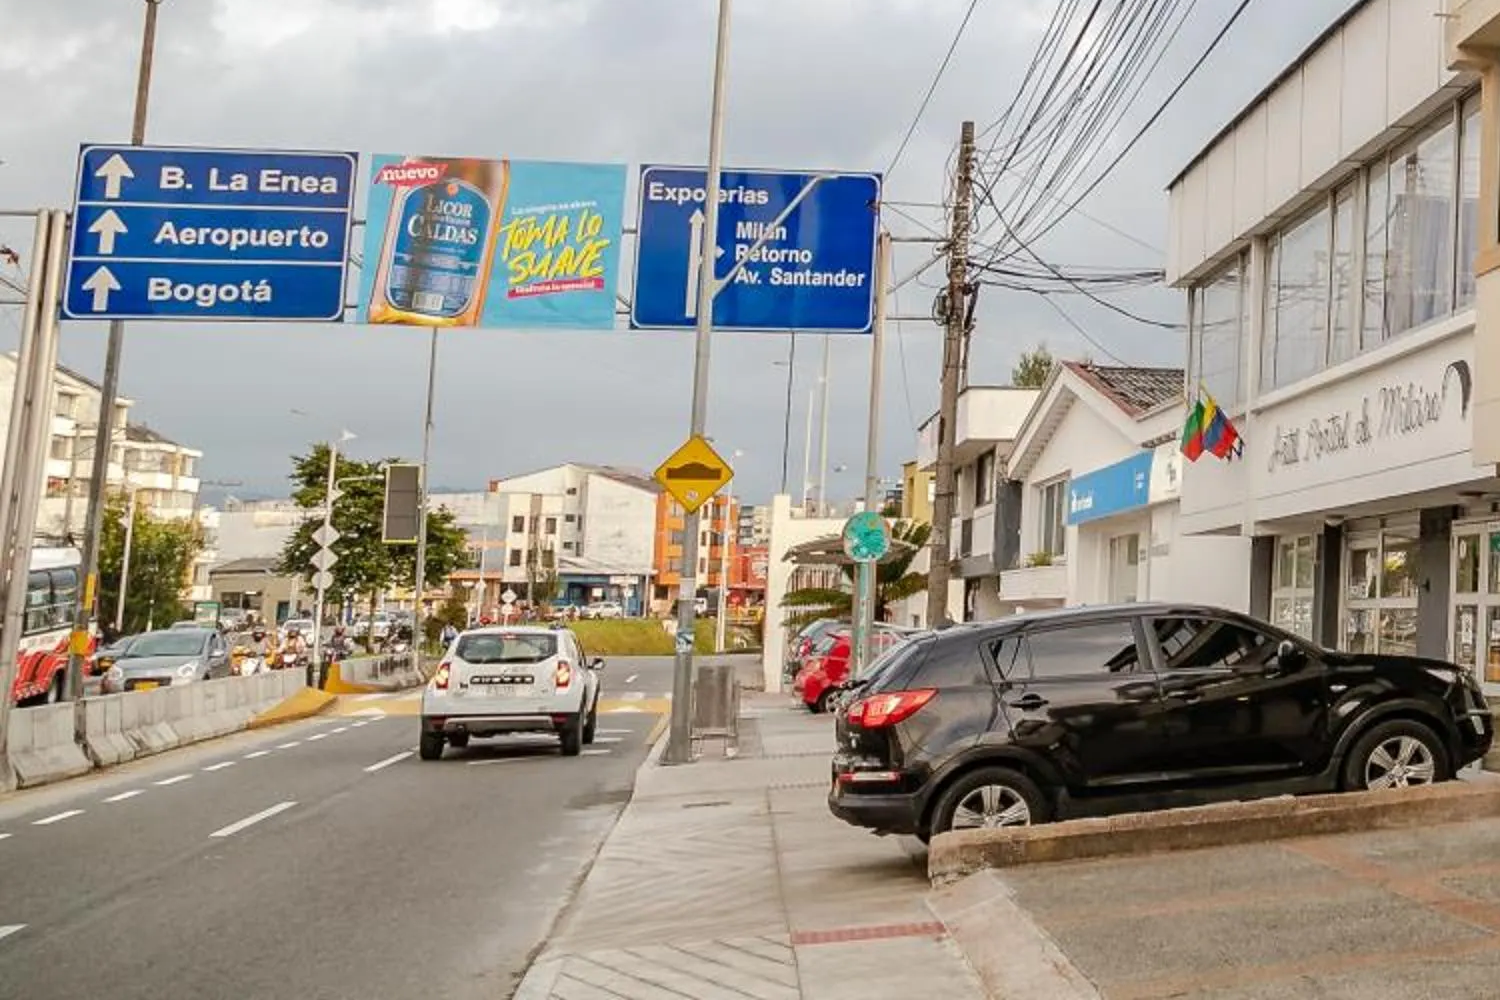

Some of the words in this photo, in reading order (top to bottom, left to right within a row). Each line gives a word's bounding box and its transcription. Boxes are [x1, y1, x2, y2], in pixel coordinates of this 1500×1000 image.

[159, 165, 193, 190] B.
[208, 167, 249, 192] La
[258, 168, 338, 194] Enea
[382, 167, 439, 181] nuevo
[648, 181, 770, 206] Expoerias
[154, 220, 329, 251] Aeropuerto
[507, 237, 610, 284] SUAVE
[735, 243, 813, 264] Retorno
[734, 266, 762, 286] Av.
[769, 267, 866, 288] Santander
[147, 276, 272, 307] Bogotá
